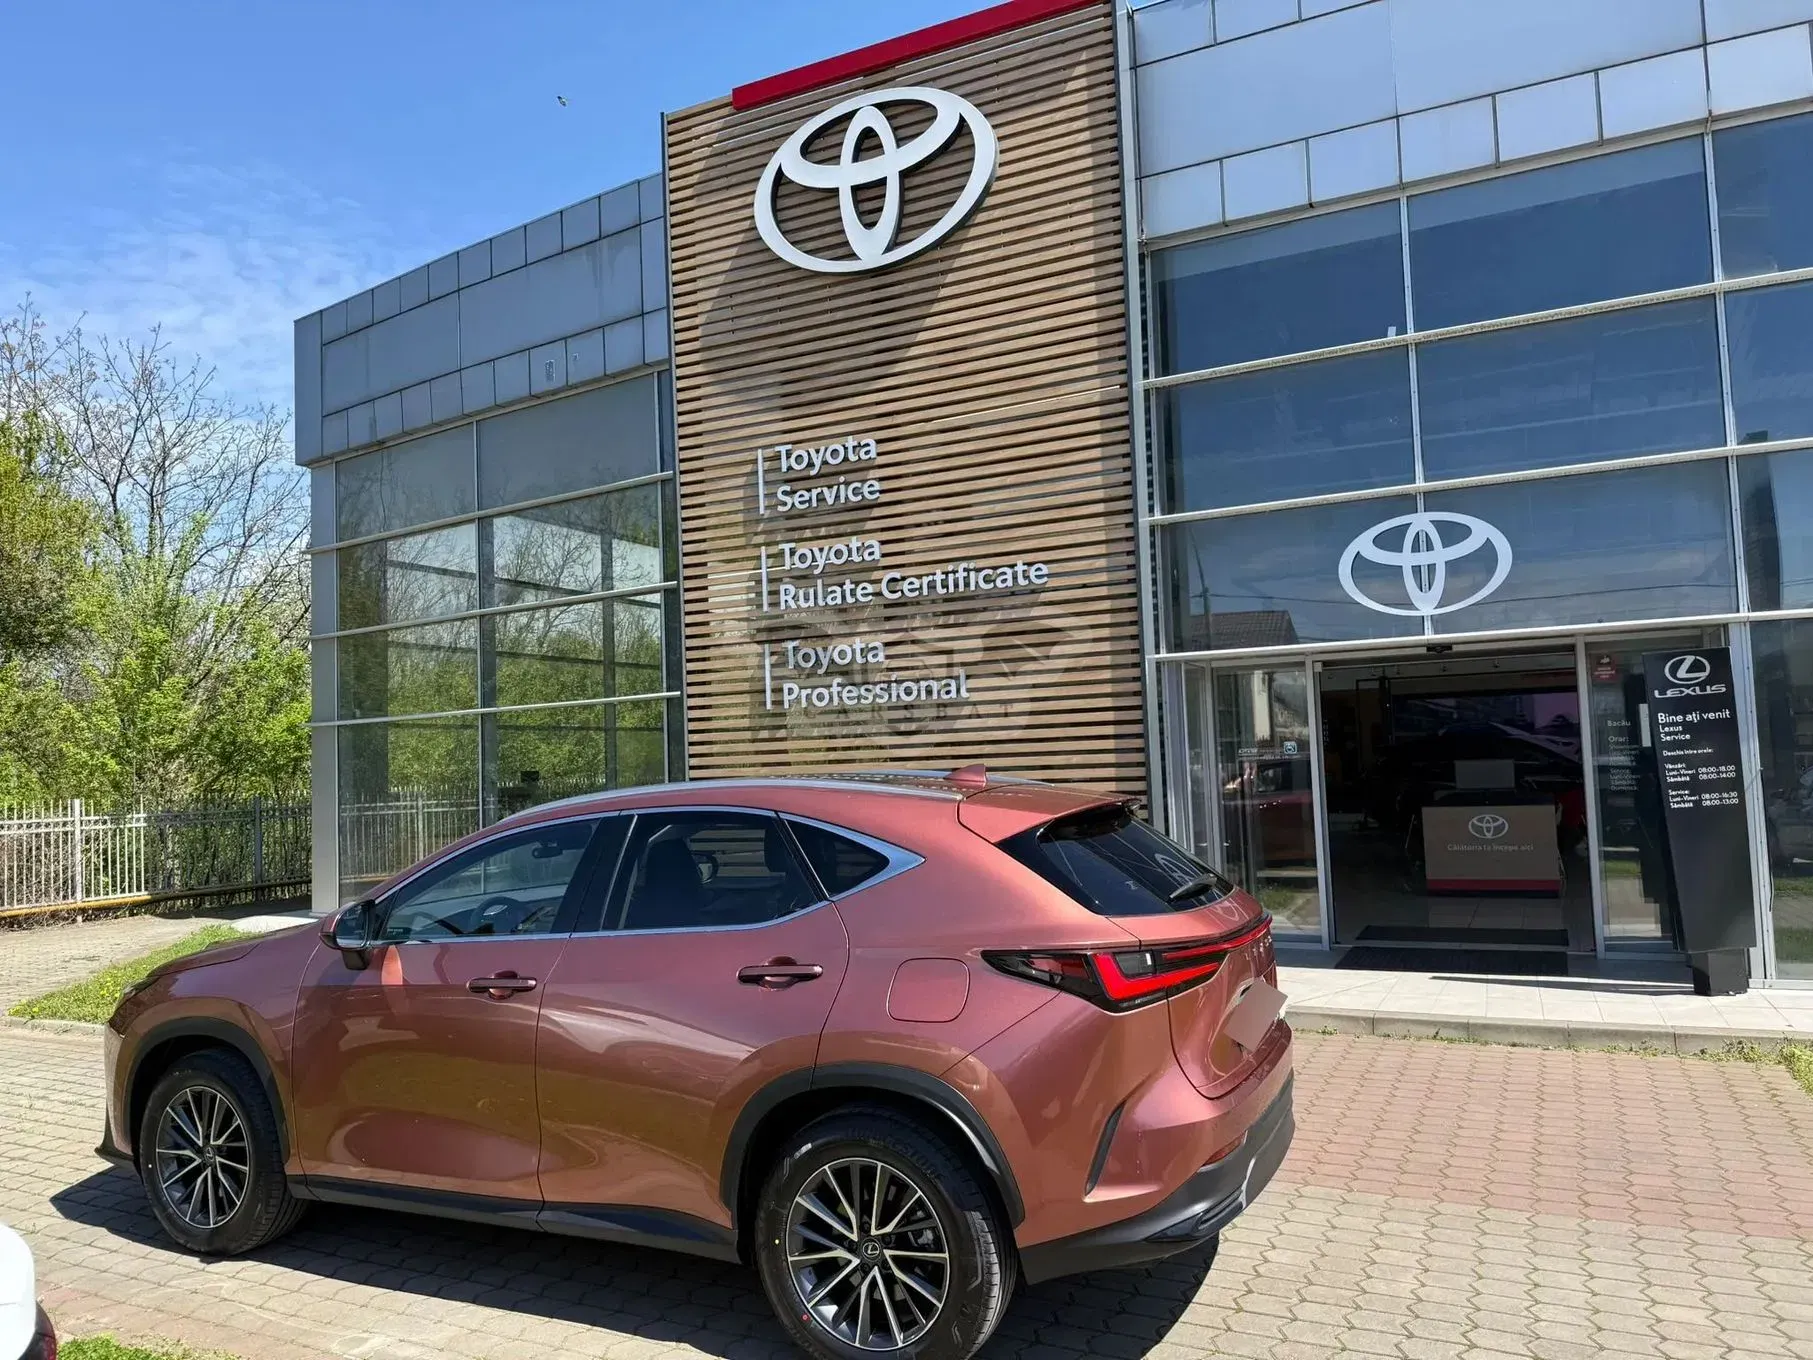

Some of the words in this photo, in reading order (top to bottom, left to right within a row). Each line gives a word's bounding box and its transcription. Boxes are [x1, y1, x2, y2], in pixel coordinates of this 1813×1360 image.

[775, 436, 877, 475] Toyota
[776, 476, 881, 512] Service
[779, 537, 881, 574] Toyota
[779, 576, 873, 610] Rulate
[881, 560, 1049, 600] Certificate
[782, 638, 884, 675] Toyota
[782, 668, 970, 709] Professional
[1654, 684, 1726, 698] LEXUS
[1657, 712, 1684, 724] Bine
[1702, 709, 1731, 721] venit
[1659, 725, 1682, 733] Lexus
[1660, 733, 1691, 741] Service
